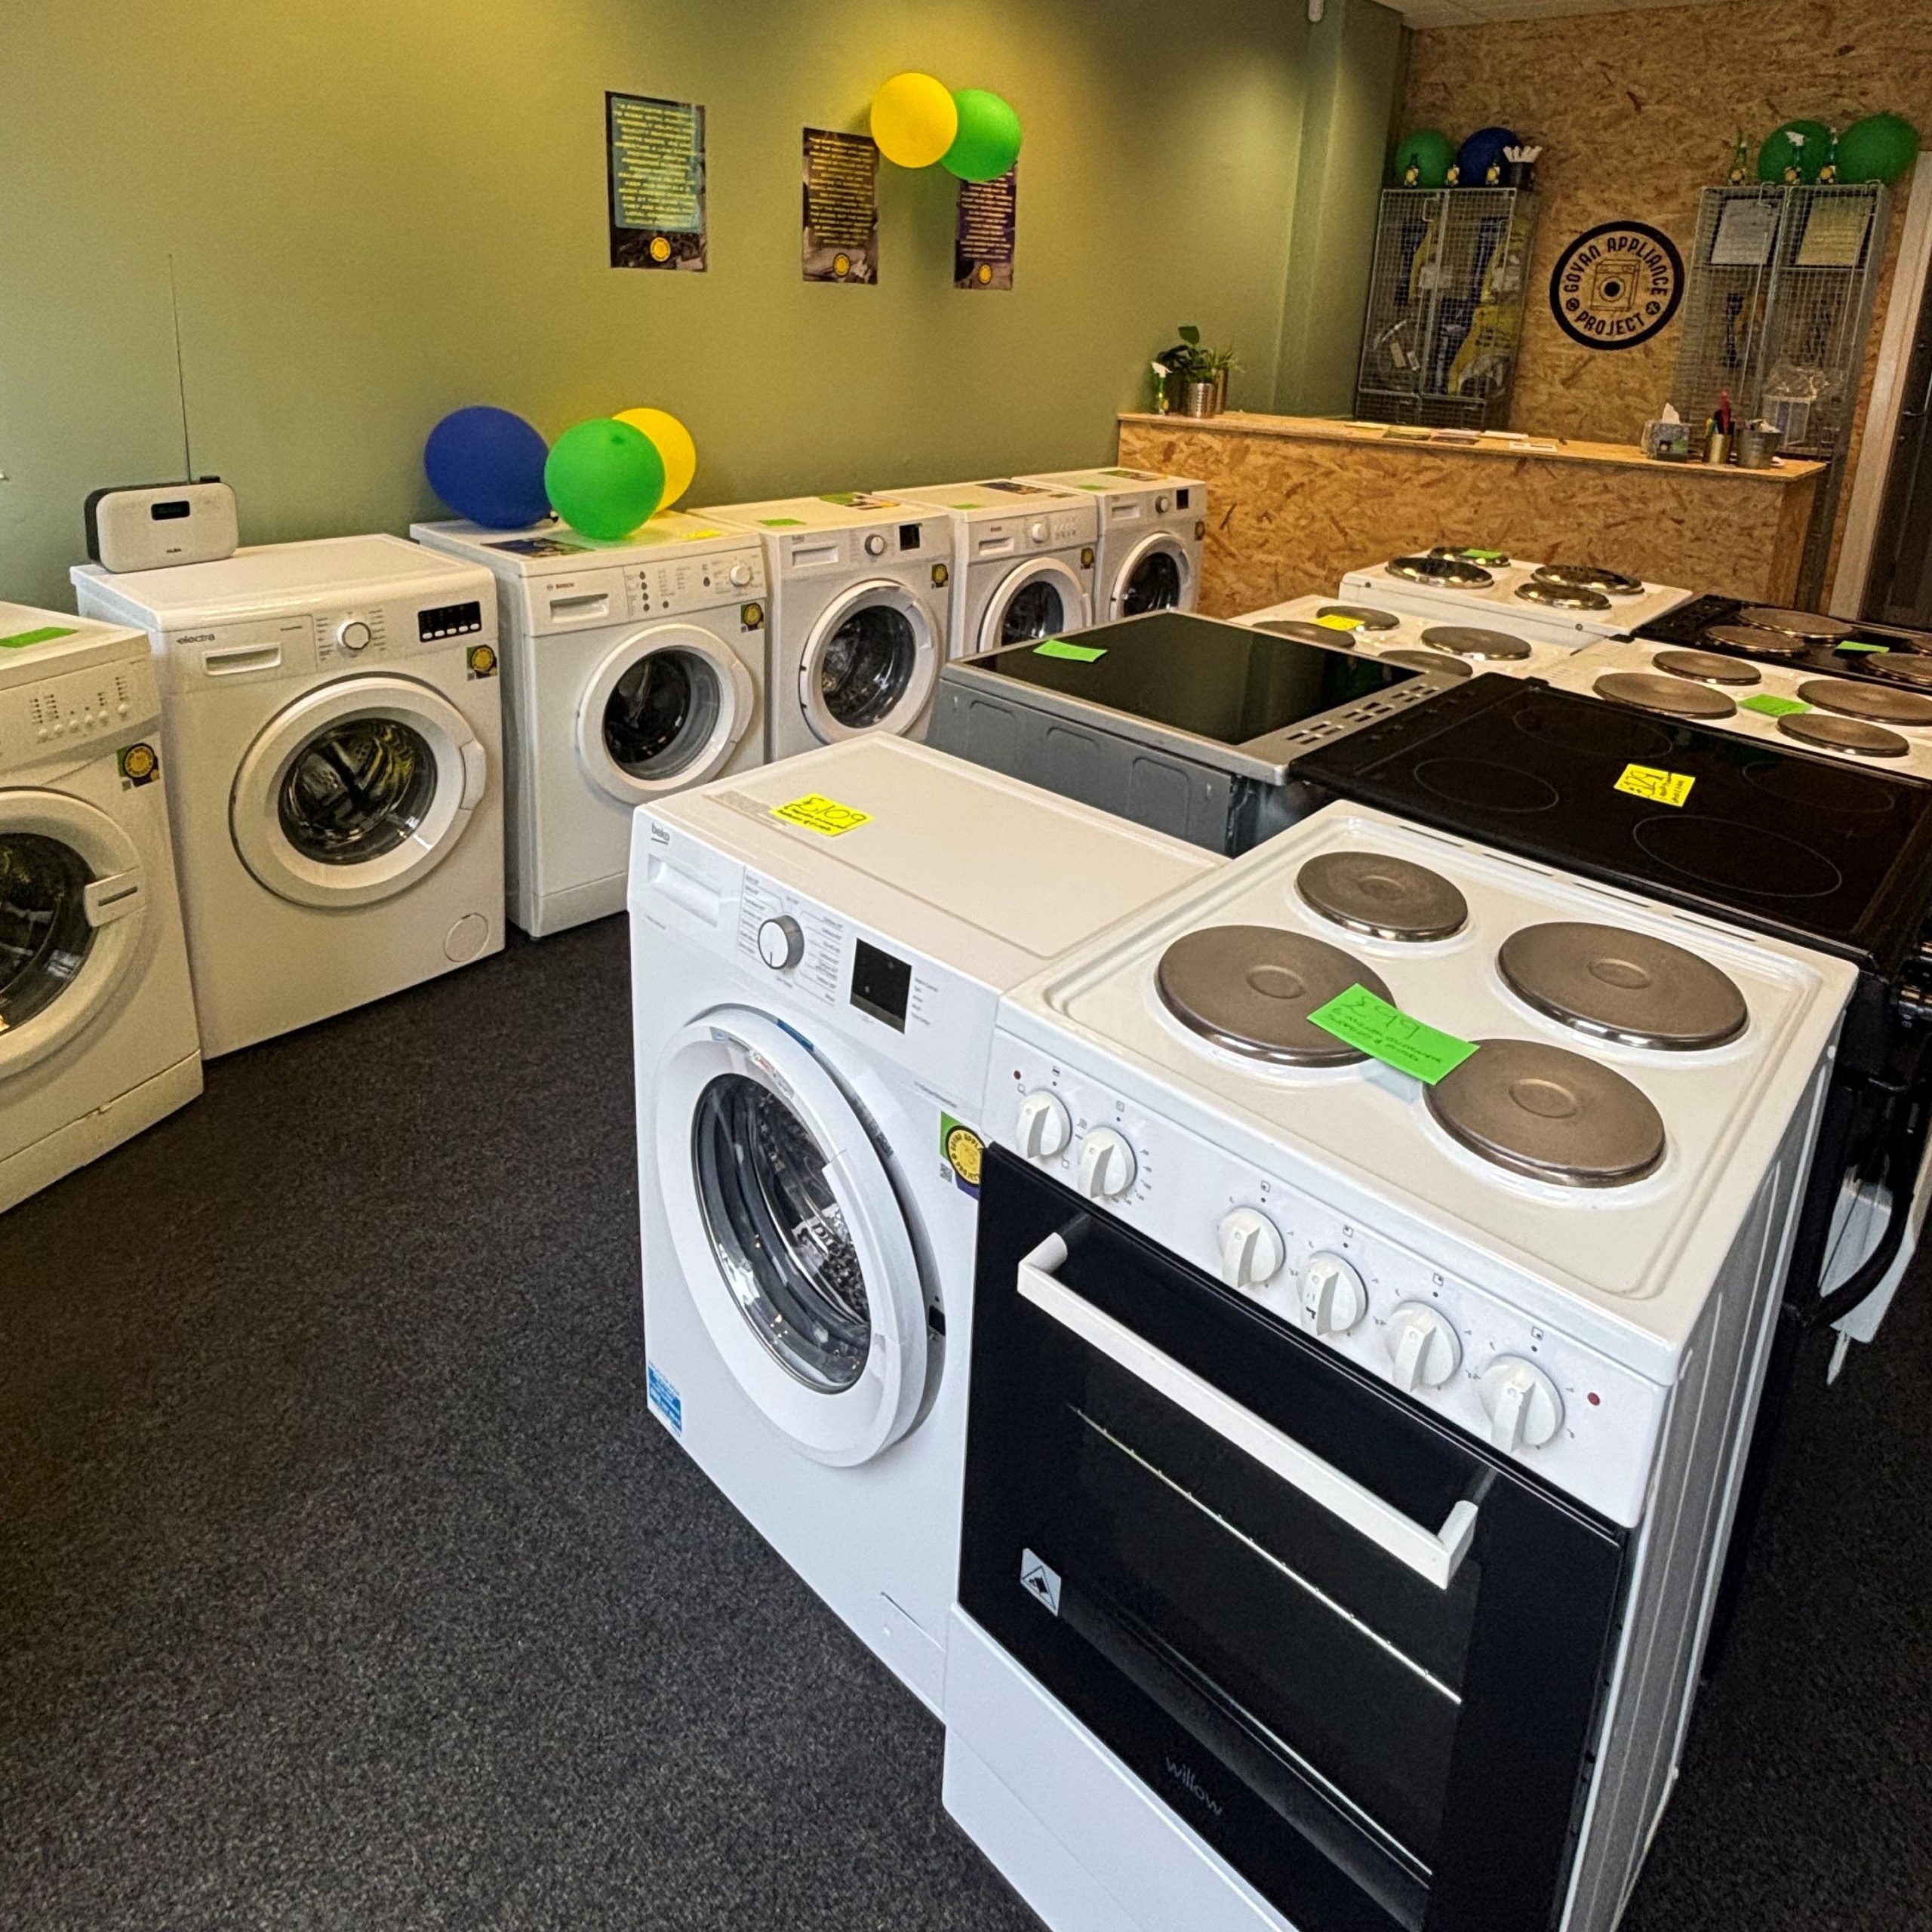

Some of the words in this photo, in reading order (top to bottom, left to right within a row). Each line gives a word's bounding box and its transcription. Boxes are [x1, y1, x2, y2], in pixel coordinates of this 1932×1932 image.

[1564, 245, 1602, 294] GOVAN
[1607, 236, 1669, 297] APPLIANCE
[1574, 310, 1646, 337] PROJECT
[797, 795, 869, 828] £109
[651, 822, 670, 842] beko
[1164, 1755, 1223, 1817] willow
